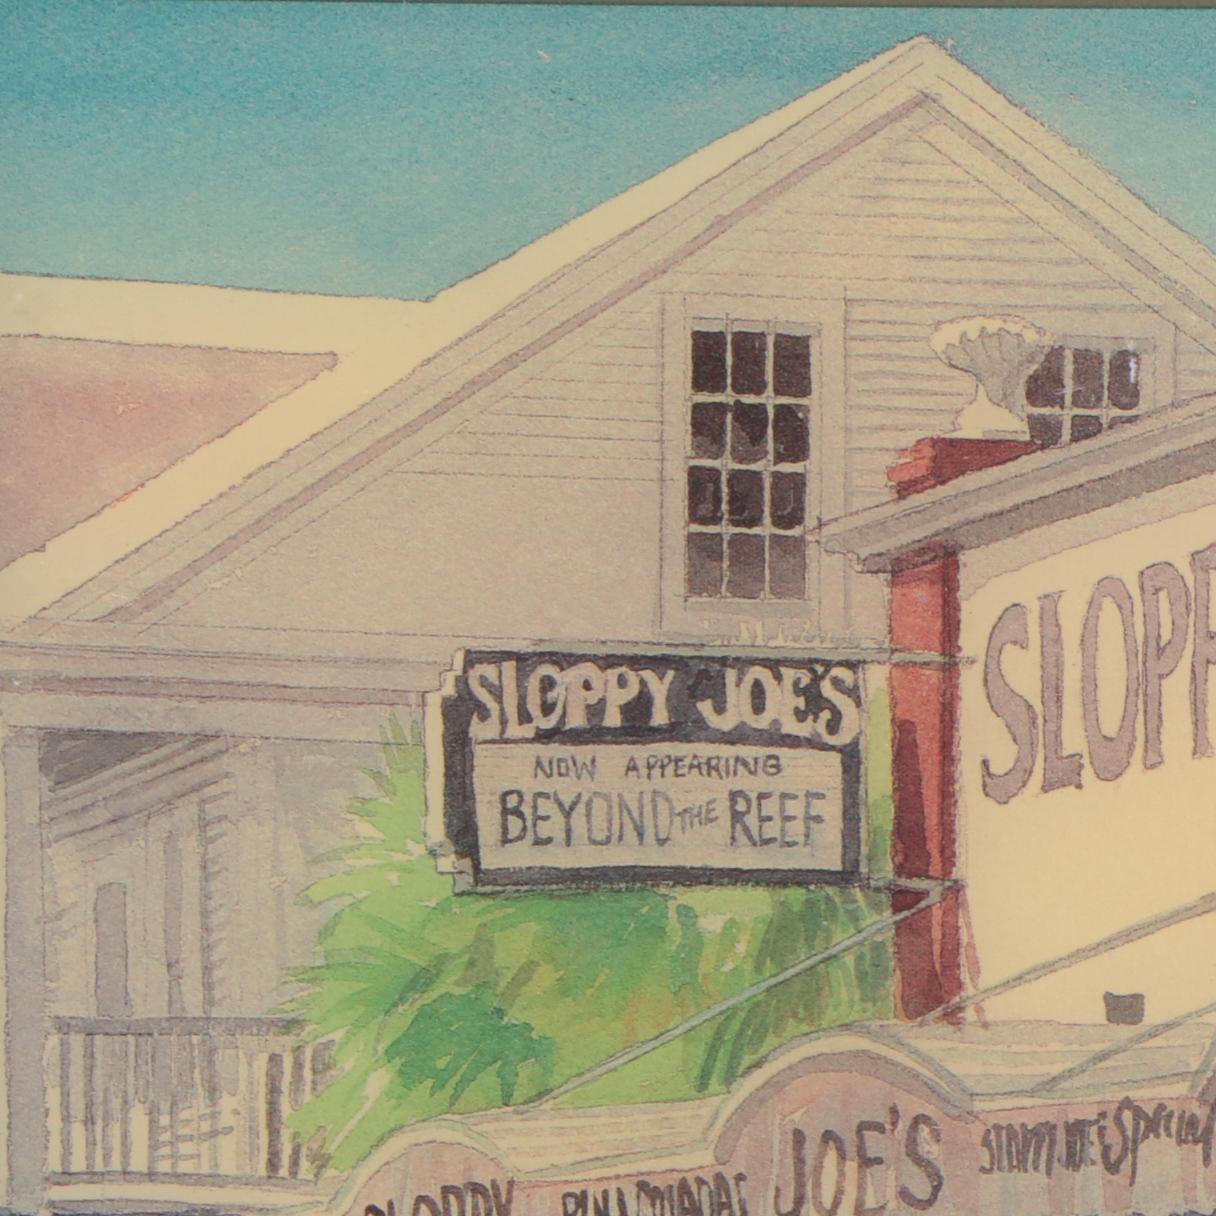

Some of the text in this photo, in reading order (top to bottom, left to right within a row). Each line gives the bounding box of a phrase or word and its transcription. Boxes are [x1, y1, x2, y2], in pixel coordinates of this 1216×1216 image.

[467, 659, 862, 746] SLOPPY JOE'S
[533, 753, 784, 780] NOW APPEARING
[500, 787, 826, 848] BEYOND THE REEF
